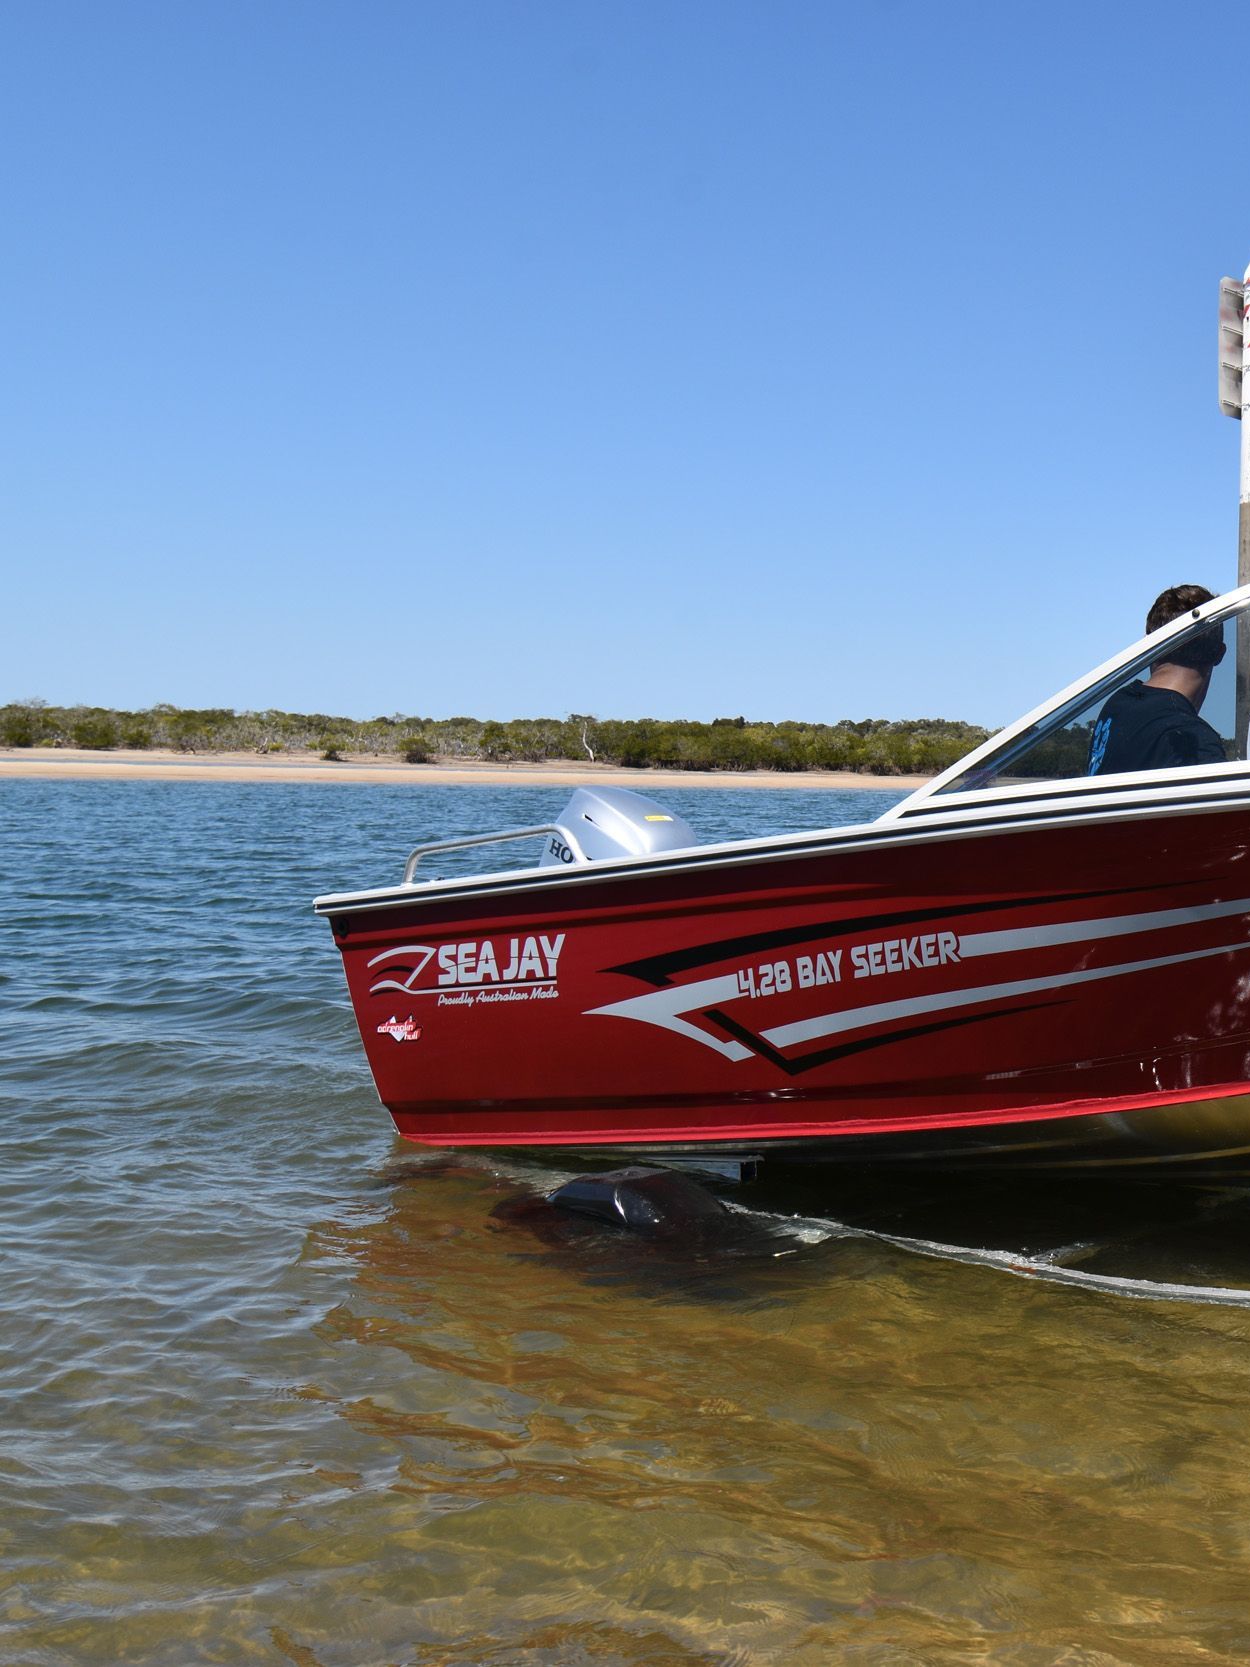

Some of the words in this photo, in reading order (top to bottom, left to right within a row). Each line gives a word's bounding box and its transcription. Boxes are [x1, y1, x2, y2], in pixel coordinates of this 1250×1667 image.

[437, 941, 500, 985] SEA
[503, 934, 566, 980] JAY
[796, 949, 843, 989] BAY
[850, 931, 961, 979] SEEKER
[438, 992, 474, 1007] Proudly
[476, 989, 529, 1003] Australian
[529, 986, 559, 1000] Made
